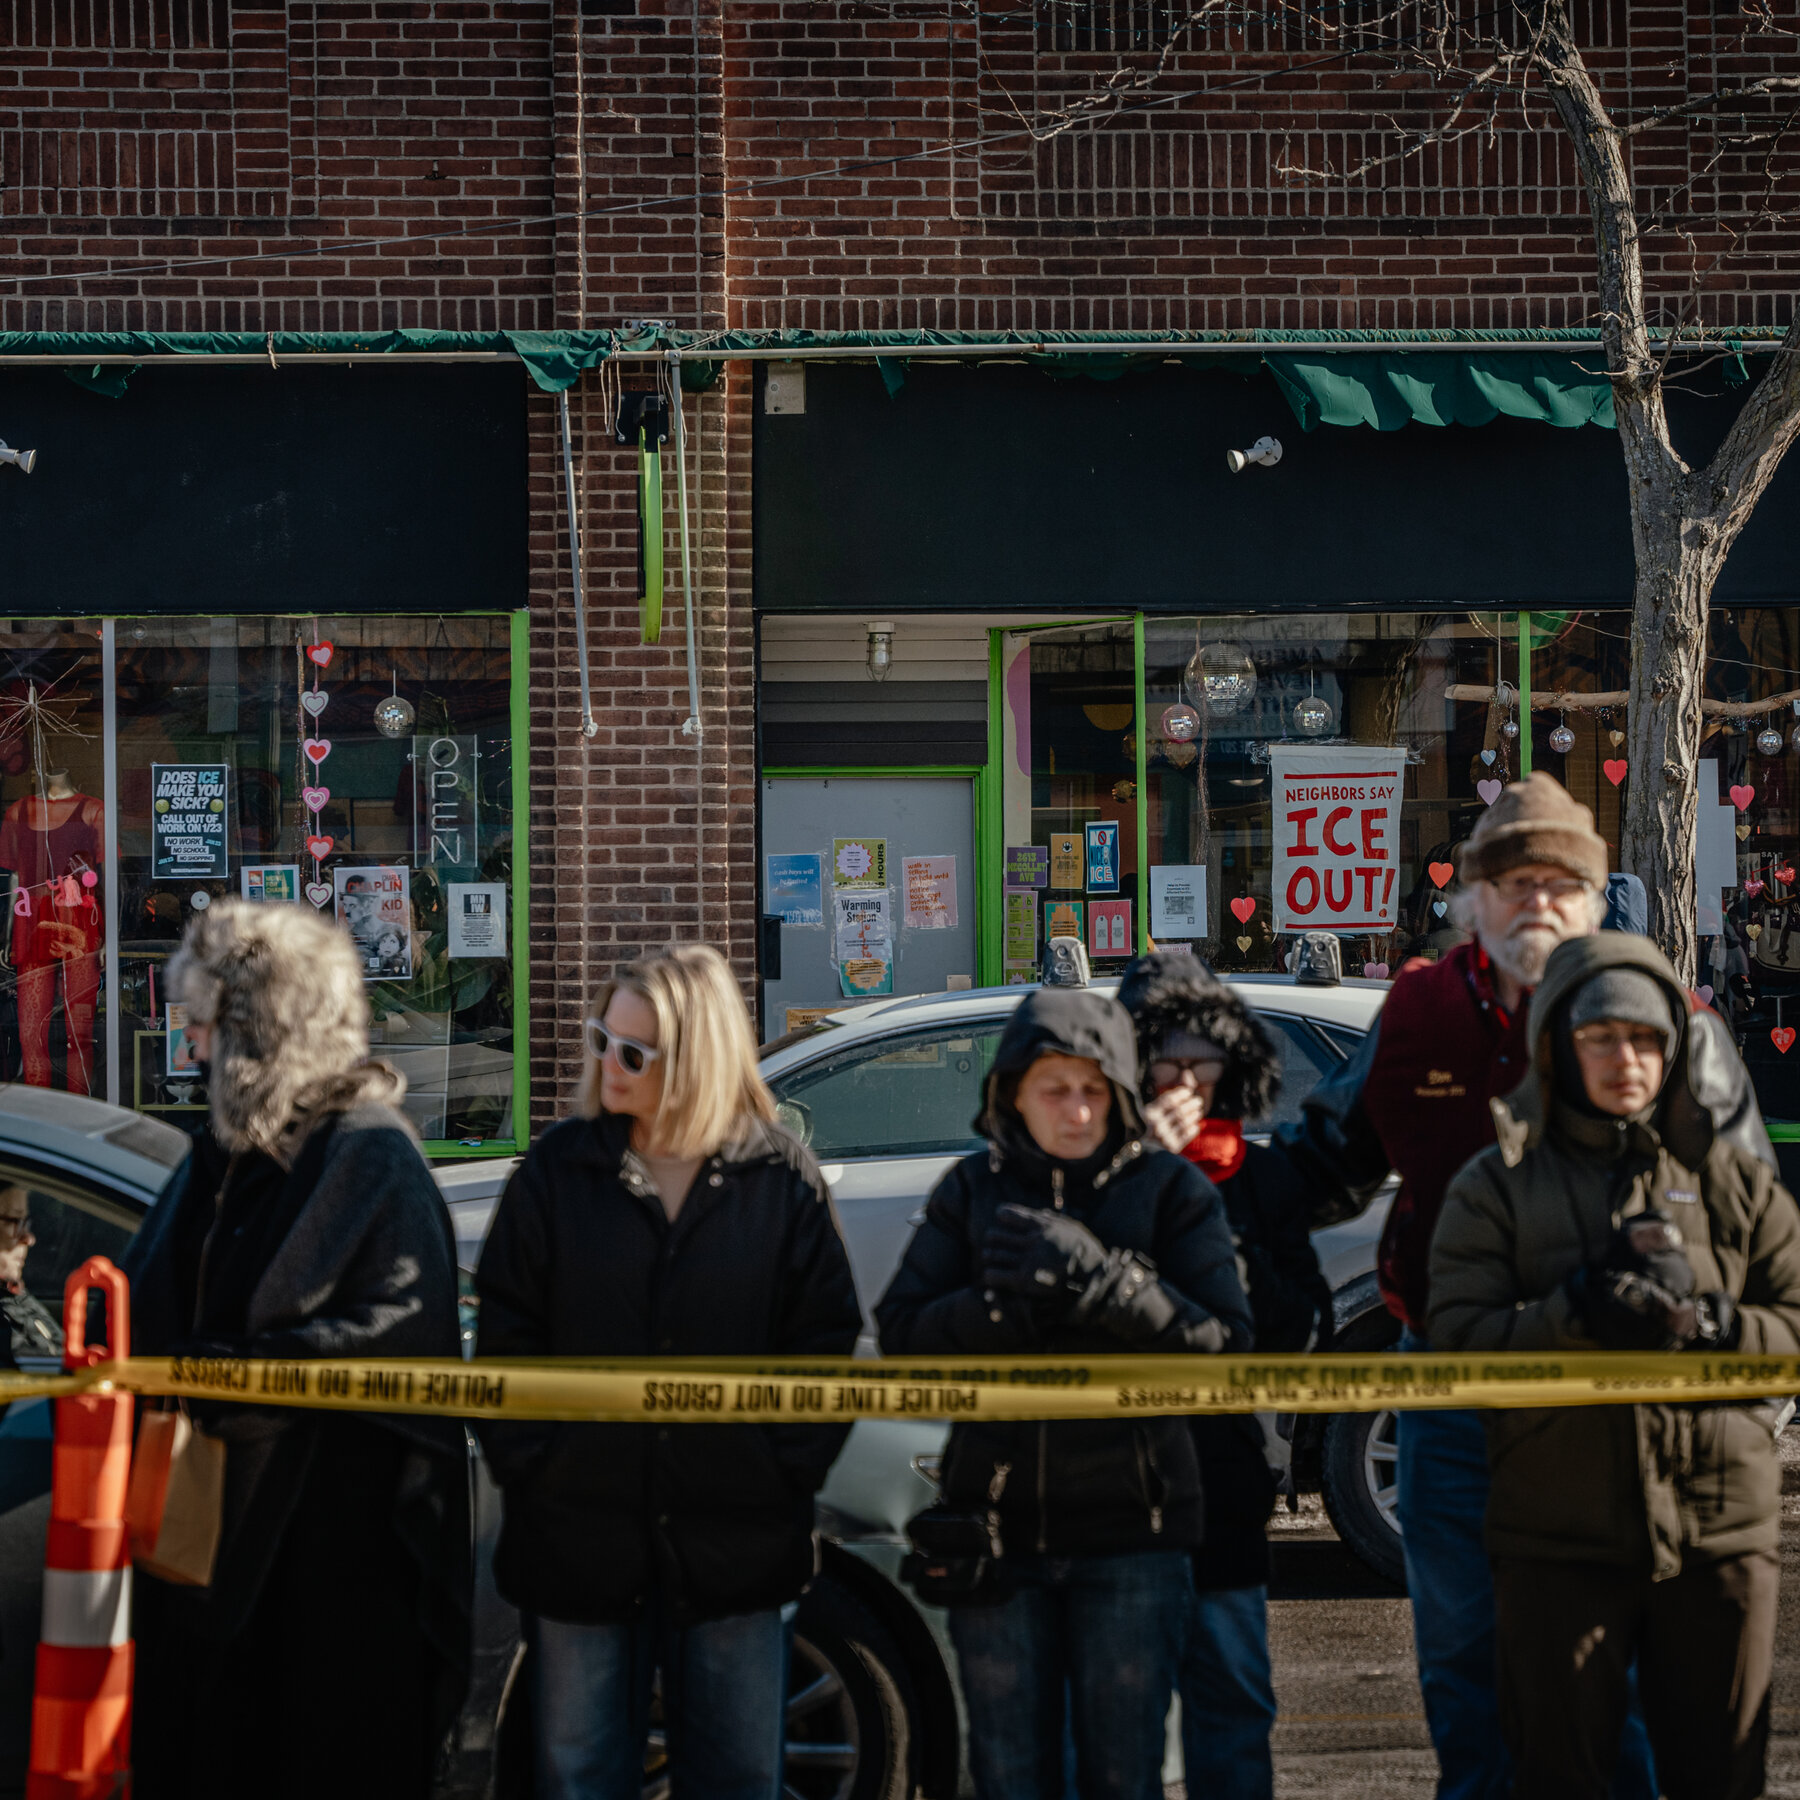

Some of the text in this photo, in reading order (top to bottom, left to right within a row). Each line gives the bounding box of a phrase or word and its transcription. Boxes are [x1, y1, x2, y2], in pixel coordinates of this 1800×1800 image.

[160, 771, 220, 784] DOES ICE
[156, 784, 225, 797] MAKE YOU
[1285, 786, 1395, 803] NEIGHBORS SAY
[170, 797, 210, 810] SICK?
[430, 738, 459, 864] OPEN
[161, 814, 219, 824] CALL OUT OF
[157, 823, 223, 833] WORK ON 1/23
[1286, 806, 1389, 860] ICE
[1019, 872, 1036, 882] AVE
[1090, 866, 1113, 882] ICE
[347, 880, 403, 893] CHAPLIN
[1286, 865, 1396, 918] OUT!
[381, 898, 403, 911] KID
[841, 900, 881, 912] Warming
[170, 1357, 504, 1407] POLICE LINE DO NOT CROSS
[643, 1381, 978, 1412] POLICE LINE DO NOT CROSS
